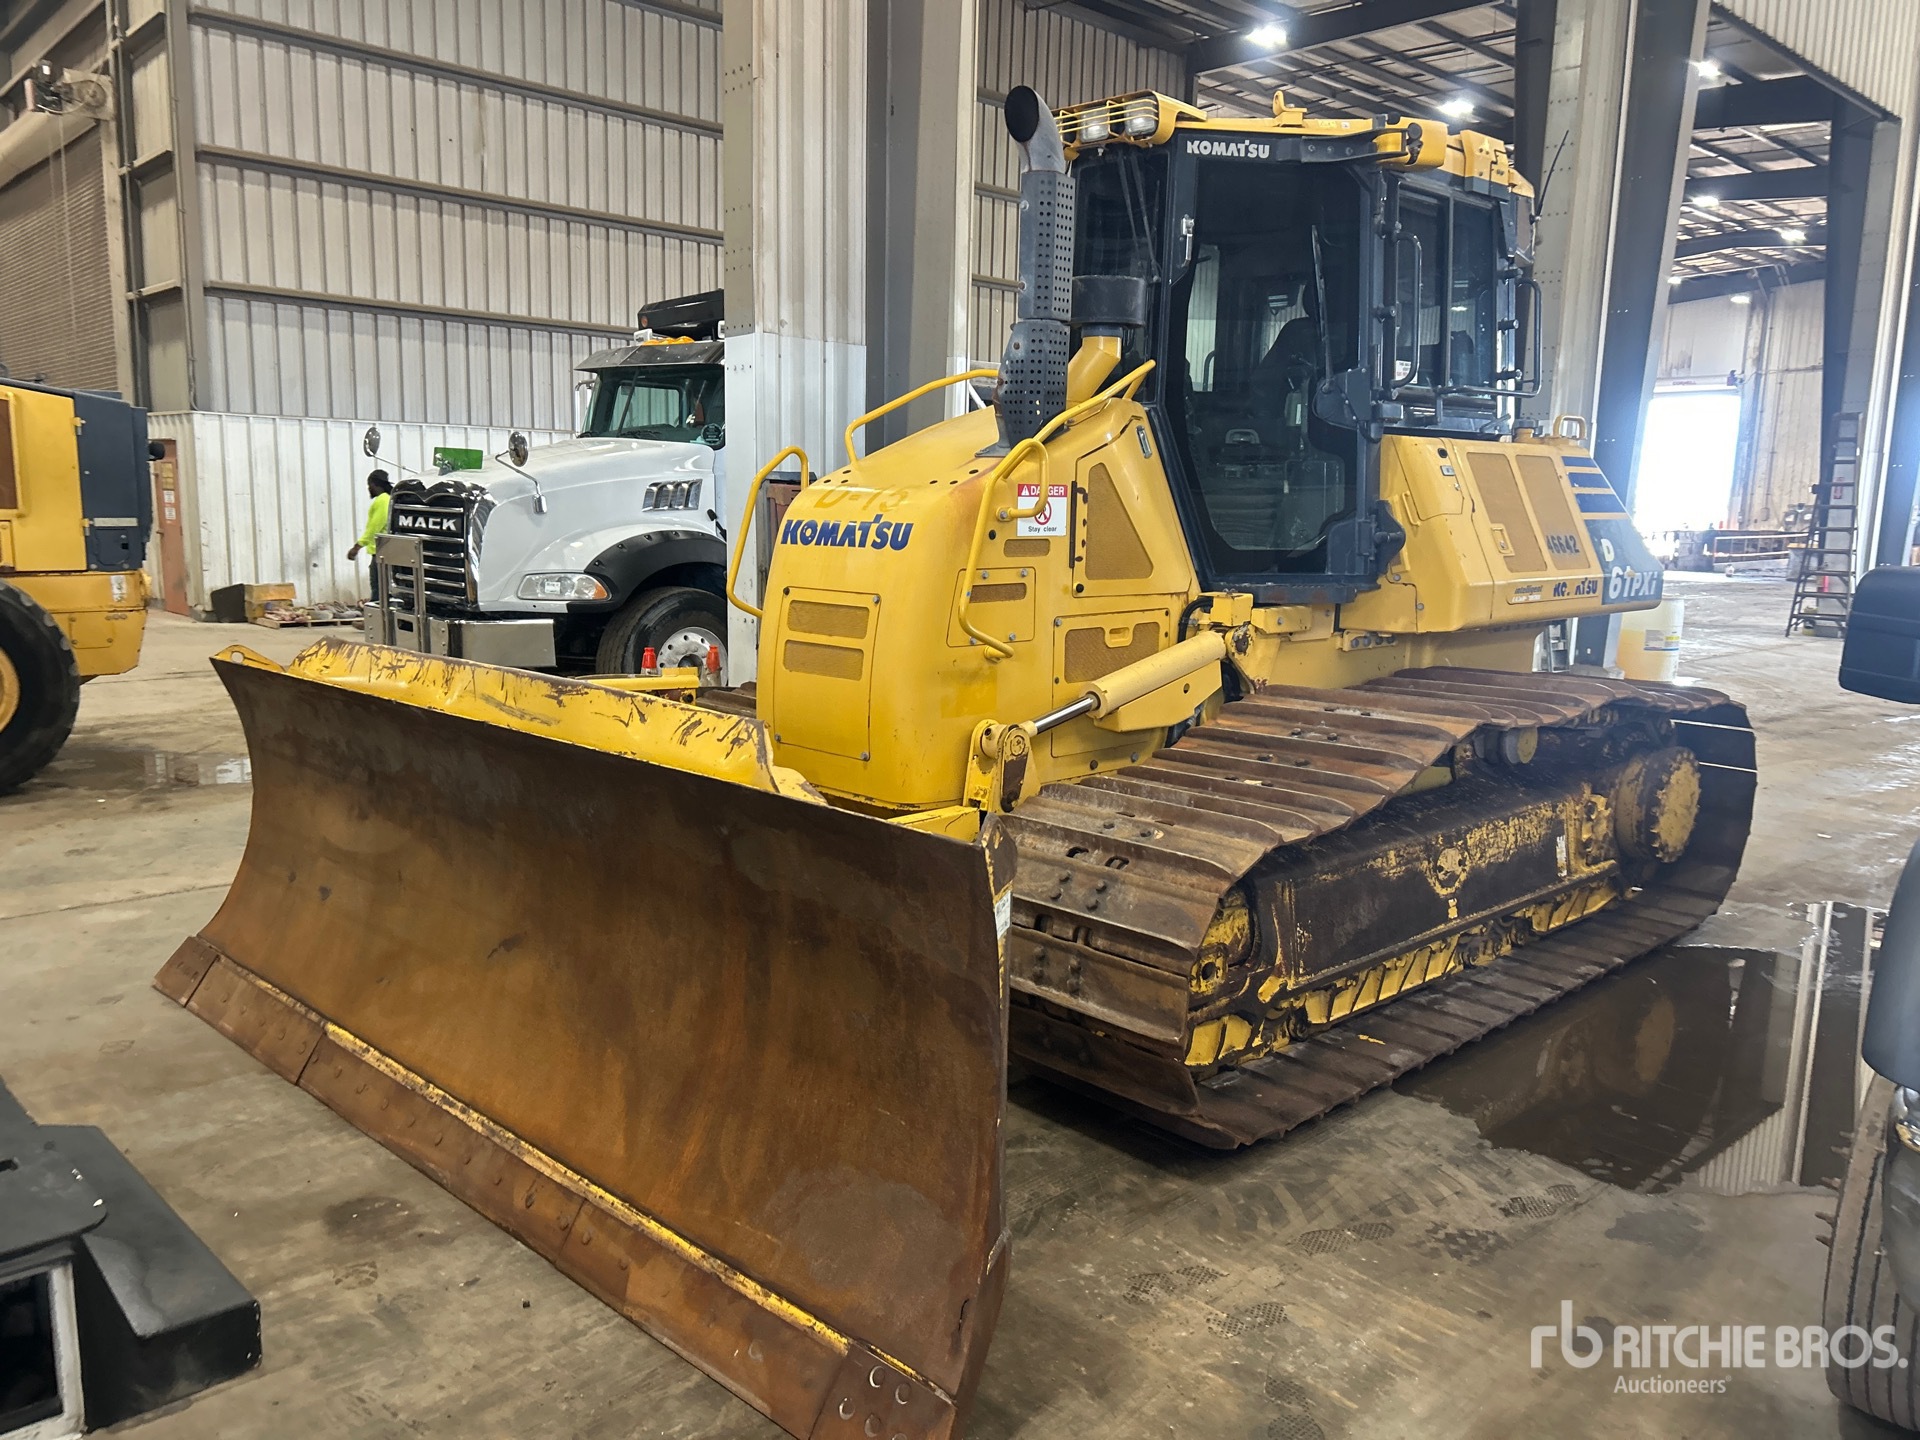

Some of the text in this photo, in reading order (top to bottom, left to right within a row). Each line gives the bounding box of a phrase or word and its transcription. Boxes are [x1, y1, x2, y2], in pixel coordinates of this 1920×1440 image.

[1186, 139, 1270, 159] KOMATSU
[1030, 485, 1065, 496] DAGER
[398, 515, 457, 531] MACK
[780, 514, 914, 551] KOMATSU
[1028, 525, 1041, 533] Stay
[1545, 534, 1581, 554] 46642
[1600, 538, 1615, 562] D
